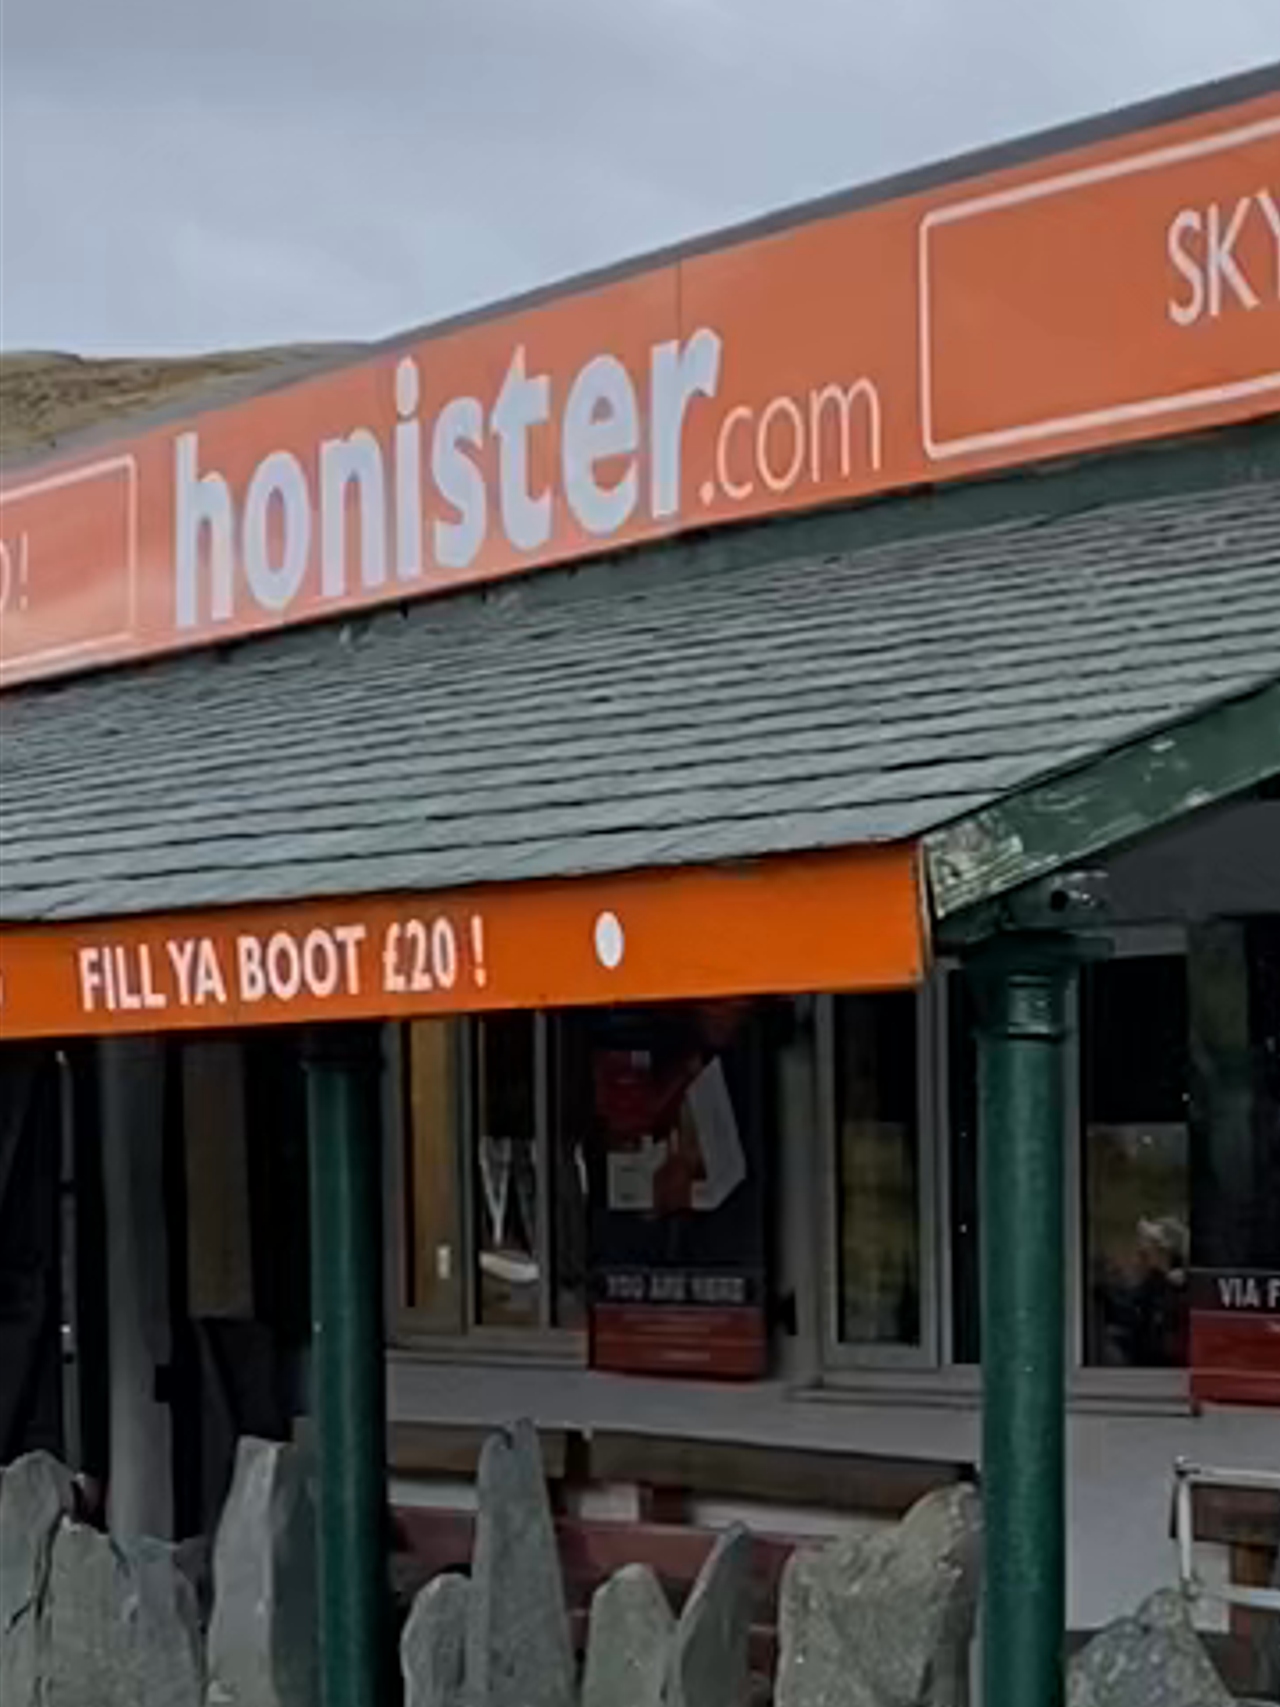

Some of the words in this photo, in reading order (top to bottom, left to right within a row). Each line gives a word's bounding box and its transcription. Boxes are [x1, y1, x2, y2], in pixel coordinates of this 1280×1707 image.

[173, 326, 882, 630] honister.com
[78, 943, 167, 1012] FILL
[166, 938, 228, 1006] YA
[237, 924, 367, 1003] BOOT
[1217, 1277, 1260, 1309] VIA
